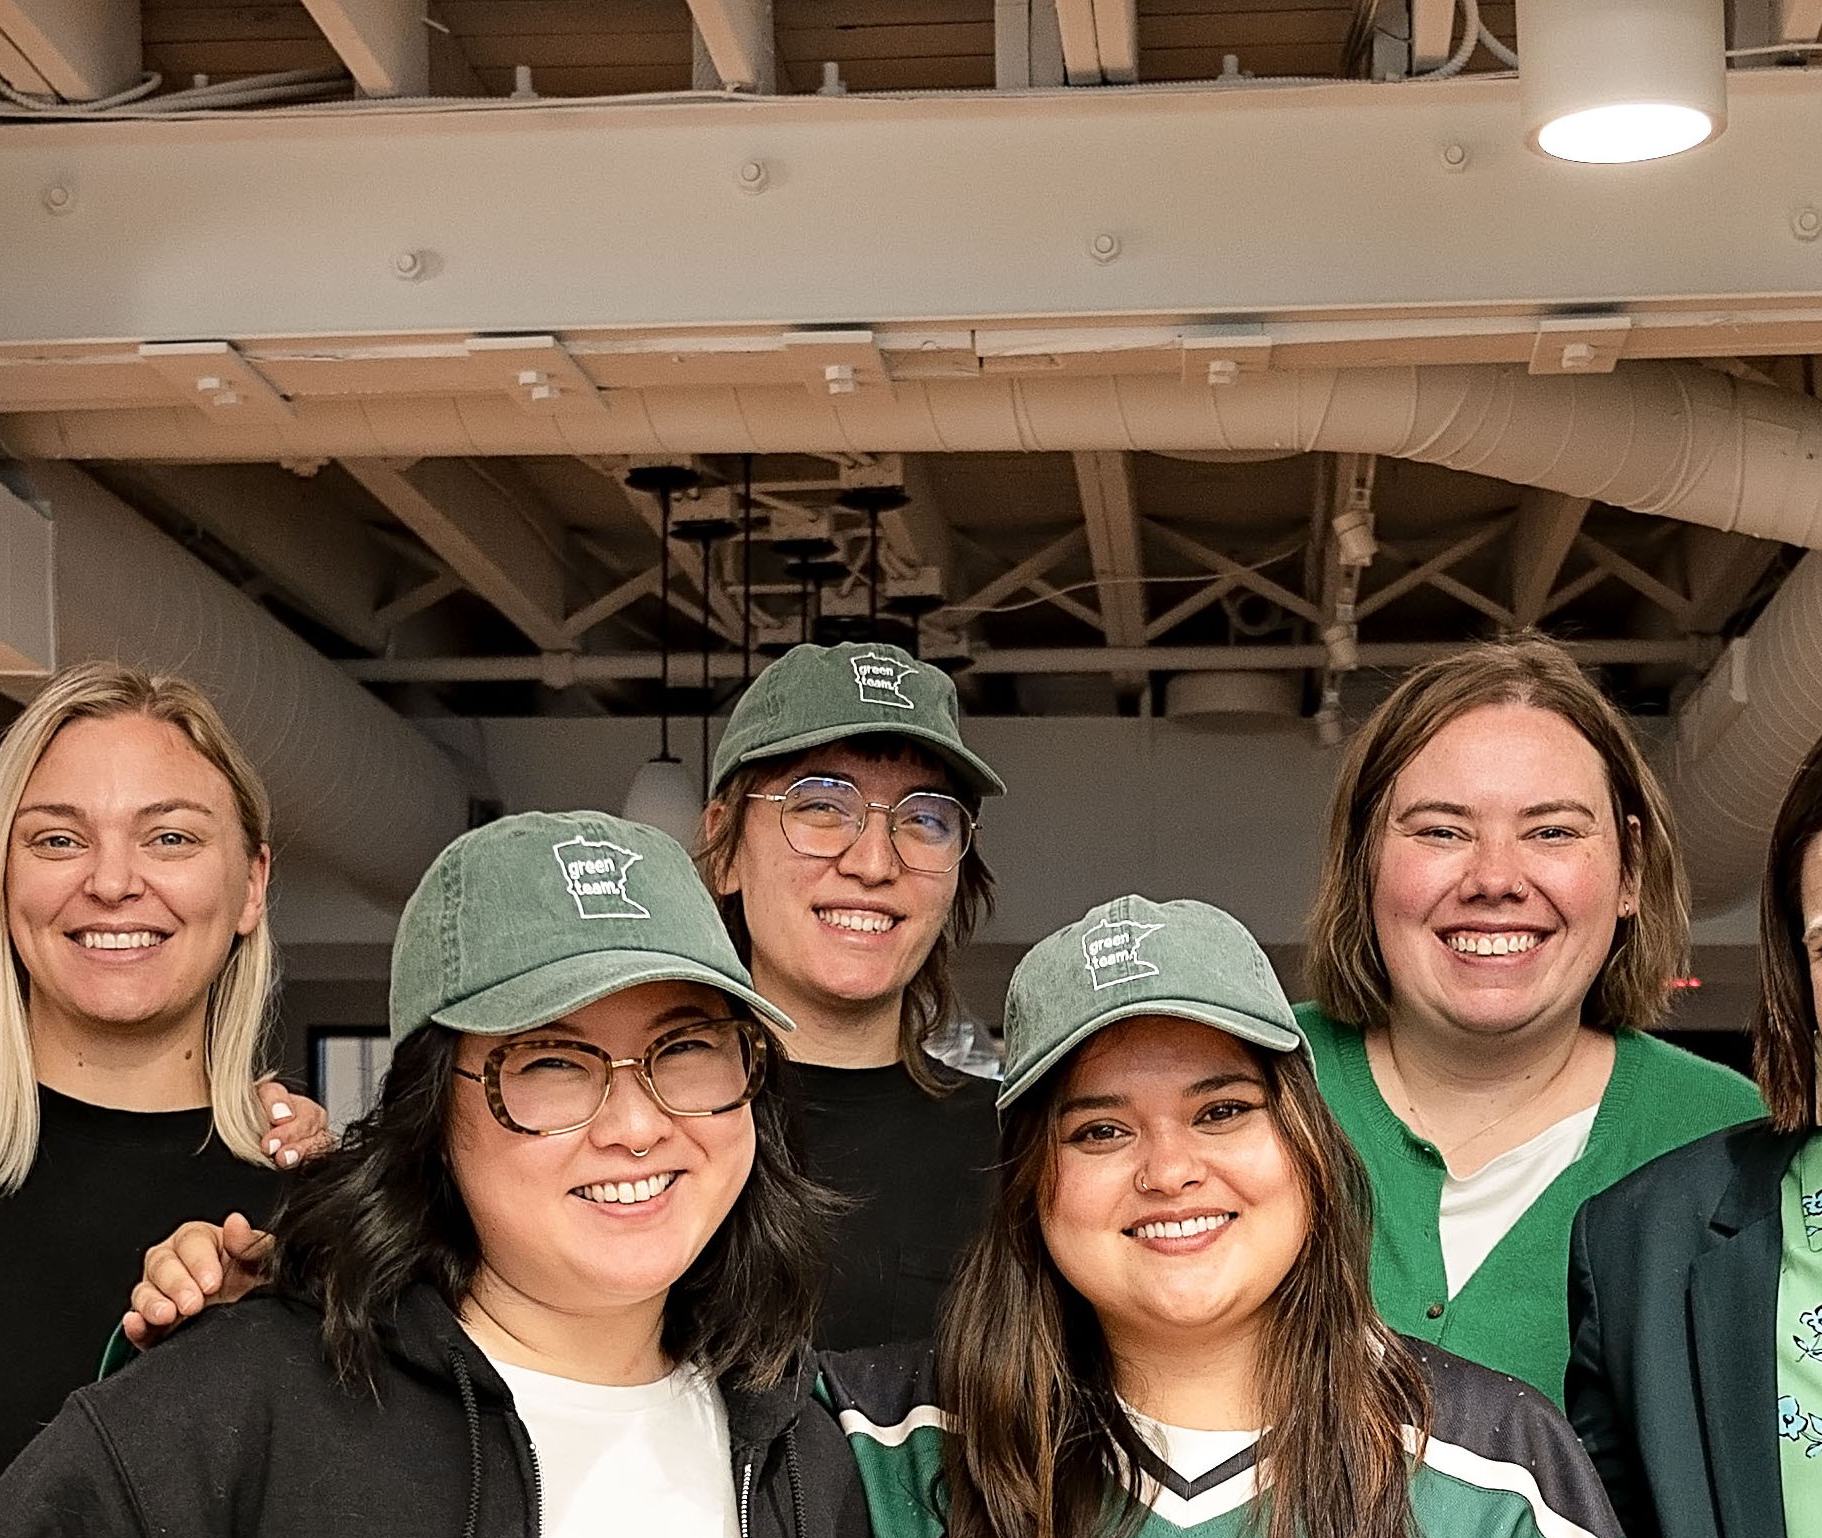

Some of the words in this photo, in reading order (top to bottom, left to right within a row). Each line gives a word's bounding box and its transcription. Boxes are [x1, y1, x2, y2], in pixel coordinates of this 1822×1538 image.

[858, 664, 894, 677] green
[567, 857, 616, 880] green
[1088, 932, 1130, 956] green
